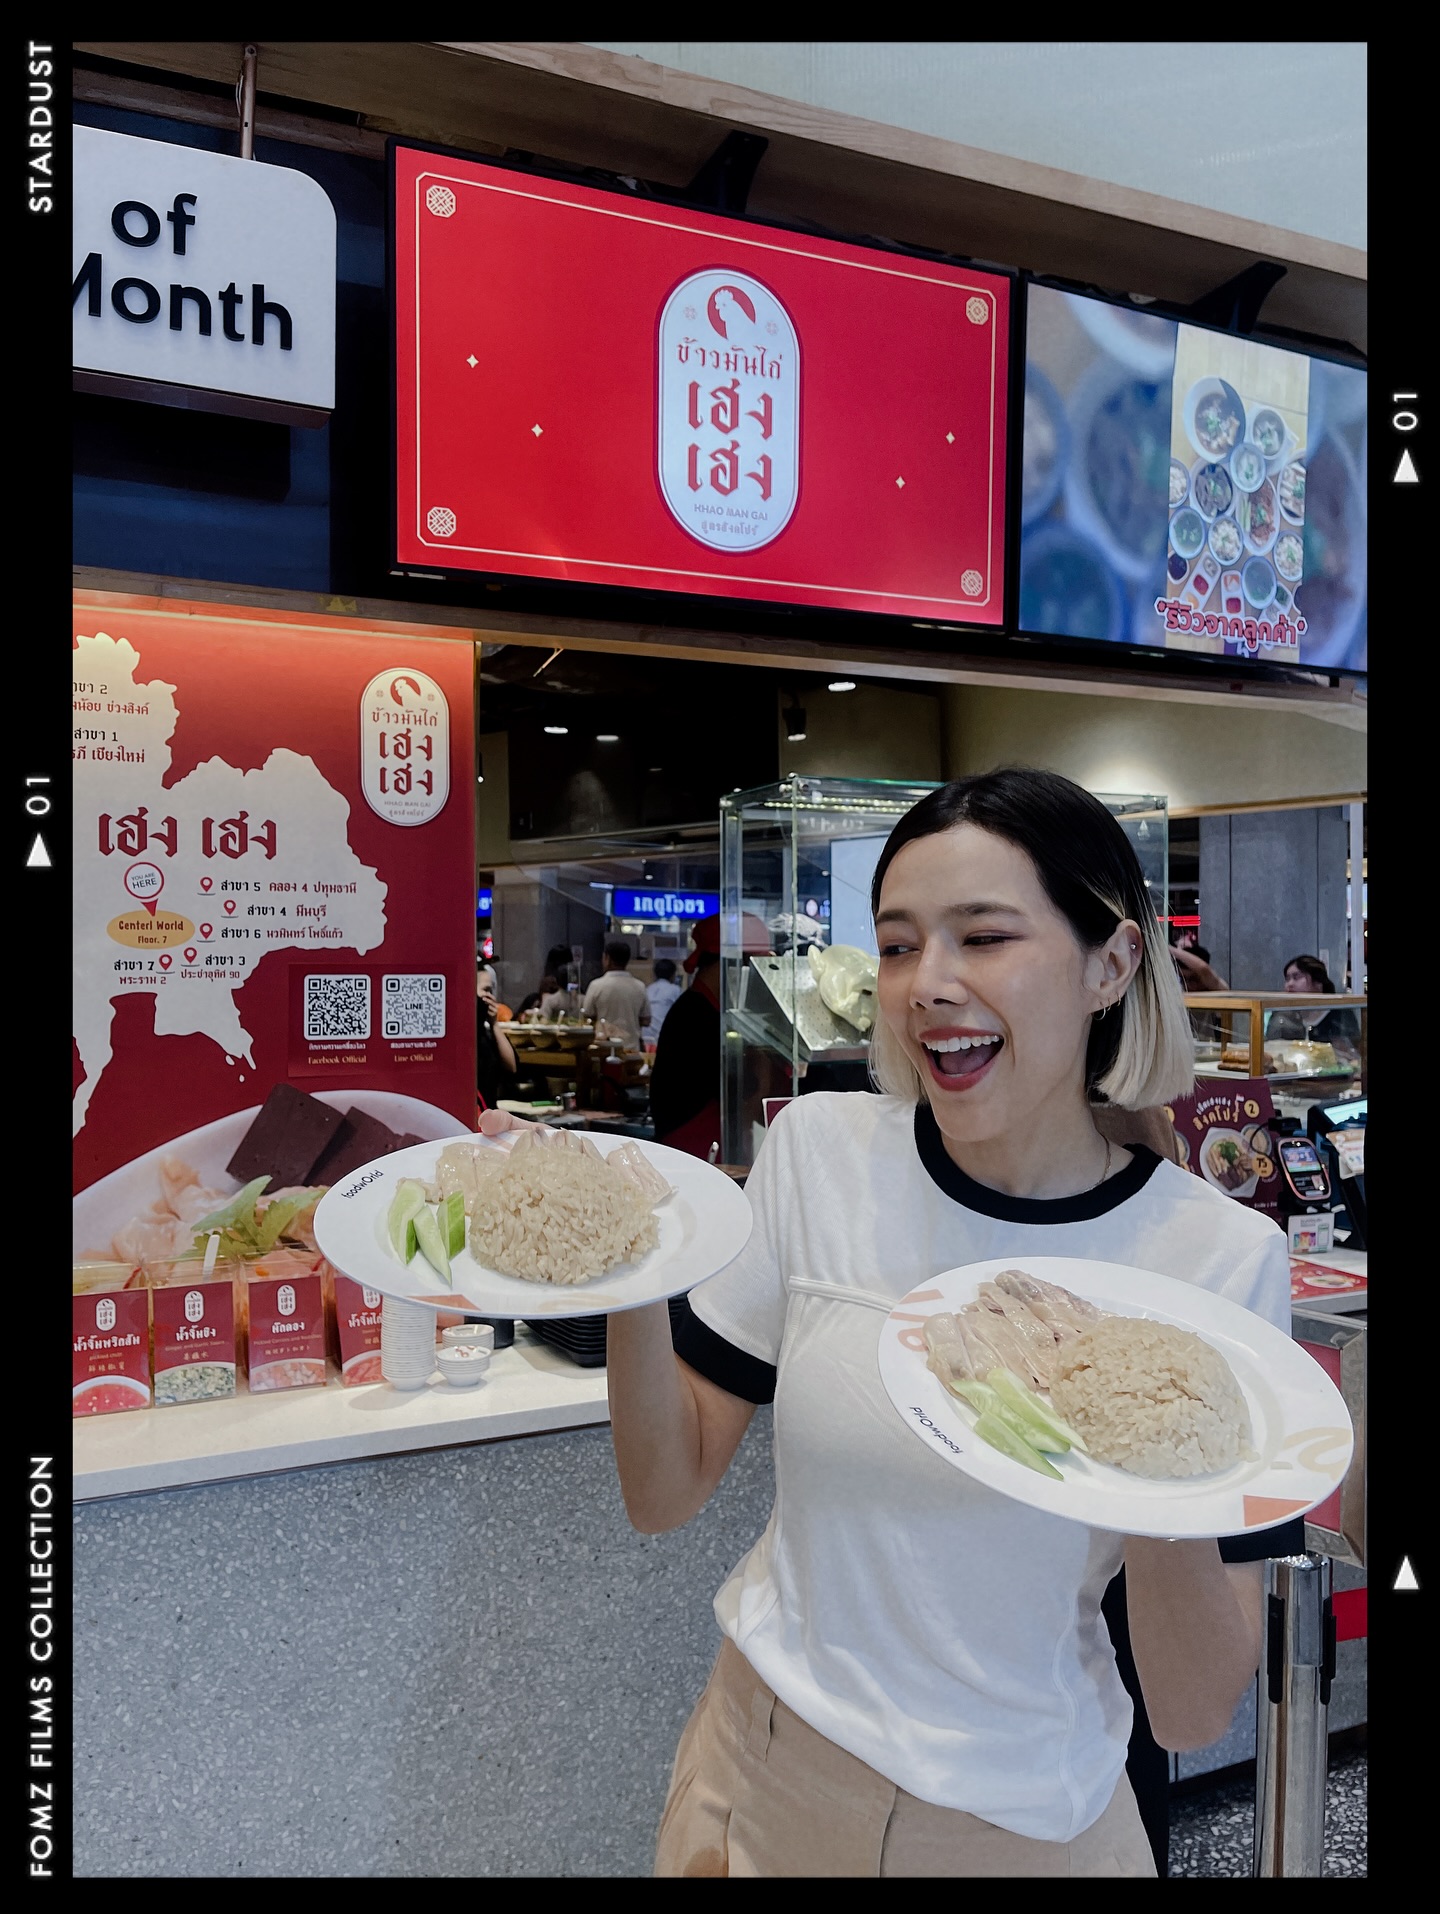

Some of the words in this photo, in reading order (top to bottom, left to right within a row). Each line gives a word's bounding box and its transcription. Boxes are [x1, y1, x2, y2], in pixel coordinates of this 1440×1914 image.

[111, 193, 197, 255] of
[677, 337, 783, 380] ข้าวมันไก่
[688, 379, 773, 440] เฮง
[688, 440, 773, 501] เฮง
[694, 503, 724, 516] KHAO
[726, 507, 749, 519] MAN
[751, 511, 768, 521] GAI
[1166, 600, 1297, 649] รีวิวจากลูกค้า
[100, 684, 108, 694] 2
[372, 707, 438, 727] ข้าวมันไก่
[74, 727, 106, 741] สาขา
[112, 731, 118, 742] 1
[379, 728, 433, 761] เฮง
[92, 745, 145, 762] เชียงใหม่
[379, 763, 433, 796] เฮง
[98, 807, 178, 858] เฮง
[202, 811, 277, 861] เฮง
[132, 877, 157, 889] HERE
[221, 879, 249, 891] สาขา
[254, 882, 261, 891] 5
[269, 882, 297, 892] คลอง
[301, 883, 308, 892] 4
[313, 881, 357, 898] ปทุมธานี
[247, 904, 275, 916] สาขา
[280, 907, 287, 916] 4
[296, 904, 327, 922] มีนบุรี
[118, 920, 153, 931] Centerl
[156, 920, 184, 931] World
[221, 927, 249, 938] สาขา
[254, 929, 261, 939] 6
[162, 935, 167, 944] 7
[114, 959, 142, 971] สาขา
[147, 961, 155, 971] 7
[205, 955, 234, 966] สาขา
[238, 956, 246, 966] 3
[160, 977, 167, 985] 2
[229, 971, 240, 979] 90
[405, 1002, 424, 1011] LINE
[308, 1056, 340, 1065] Facebook
[342, 1055, 367, 1064] Official
[394, 1054, 409, 1062] Line
[410, 1053, 434, 1062] Official
[1248, 1103, 1256, 1115] 2
